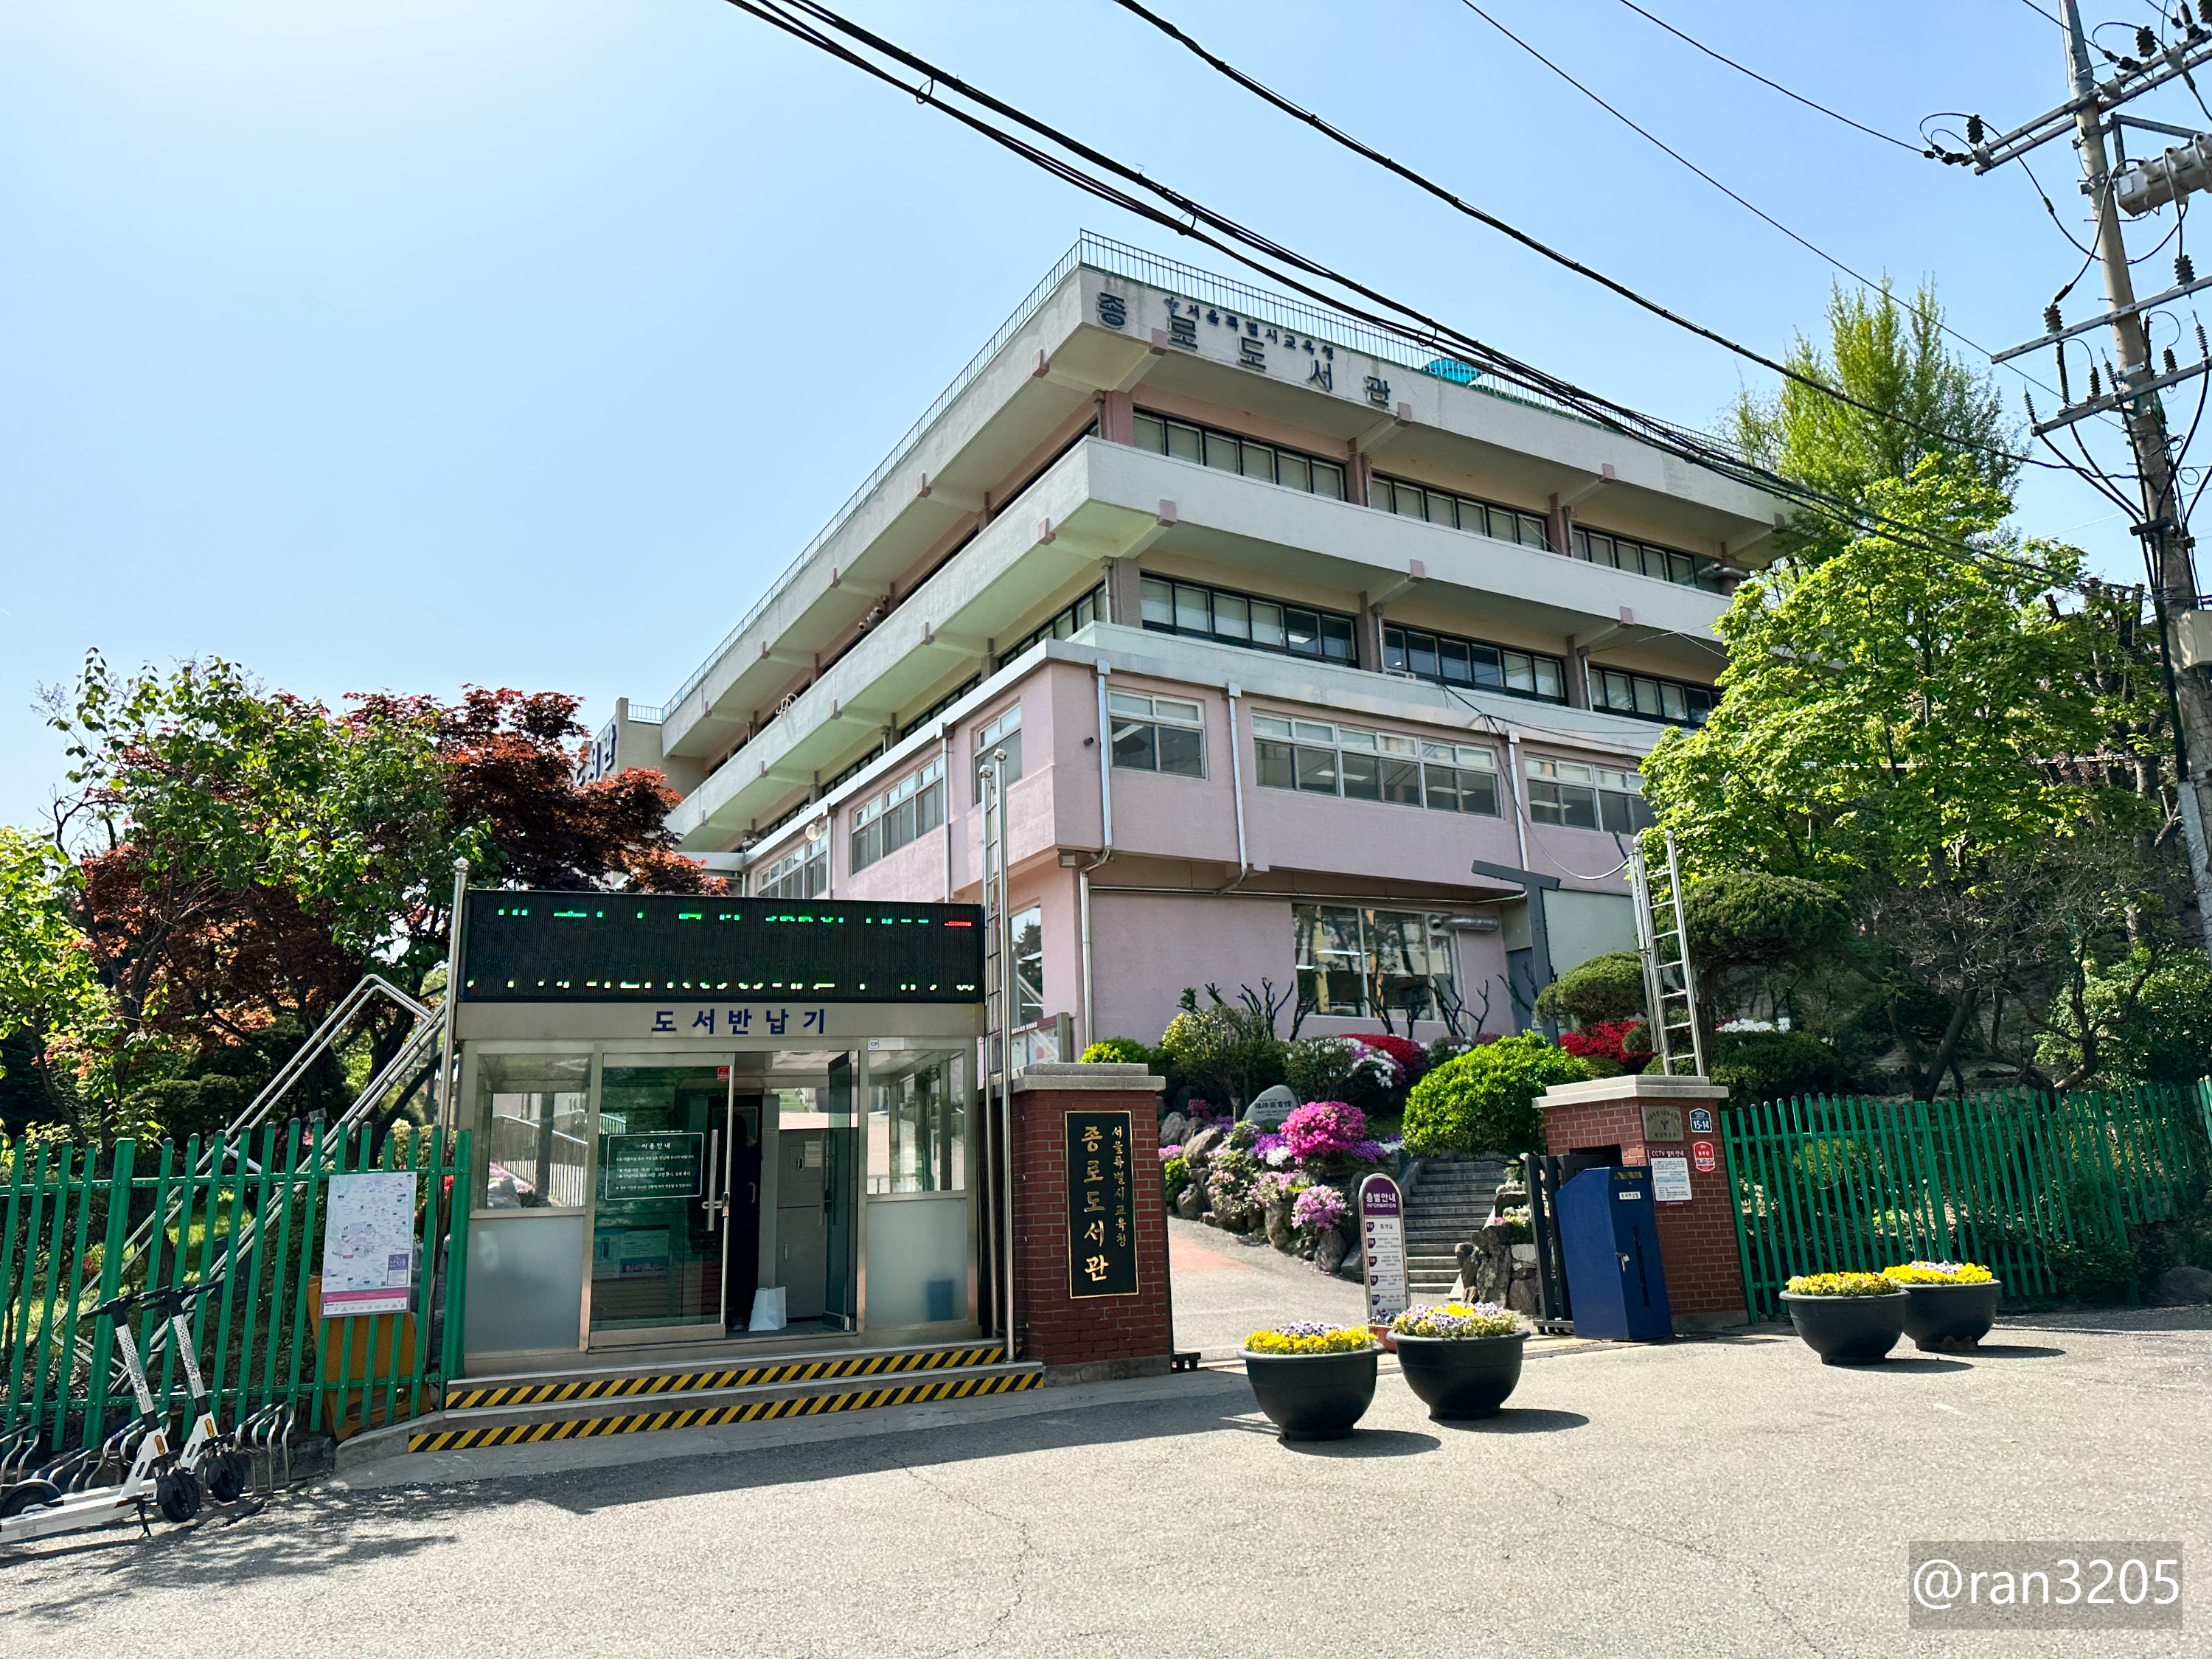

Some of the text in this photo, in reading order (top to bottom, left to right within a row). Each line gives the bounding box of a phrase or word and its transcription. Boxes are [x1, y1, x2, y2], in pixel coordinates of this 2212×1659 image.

[1096, 292, 1391, 408] 종로도서관
[1186, 305, 1334, 361] 서울특별시교육청
[651, 1008, 825, 1034] 도서반납기
[1694, 1120, 1709, 1129] 15-14
[1081, 1126, 1109, 1281] 종로도서관
[1112, 1126, 1127, 1247] 서울특별시교육청
[1366, 1192, 1397, 1203] 층별안내
